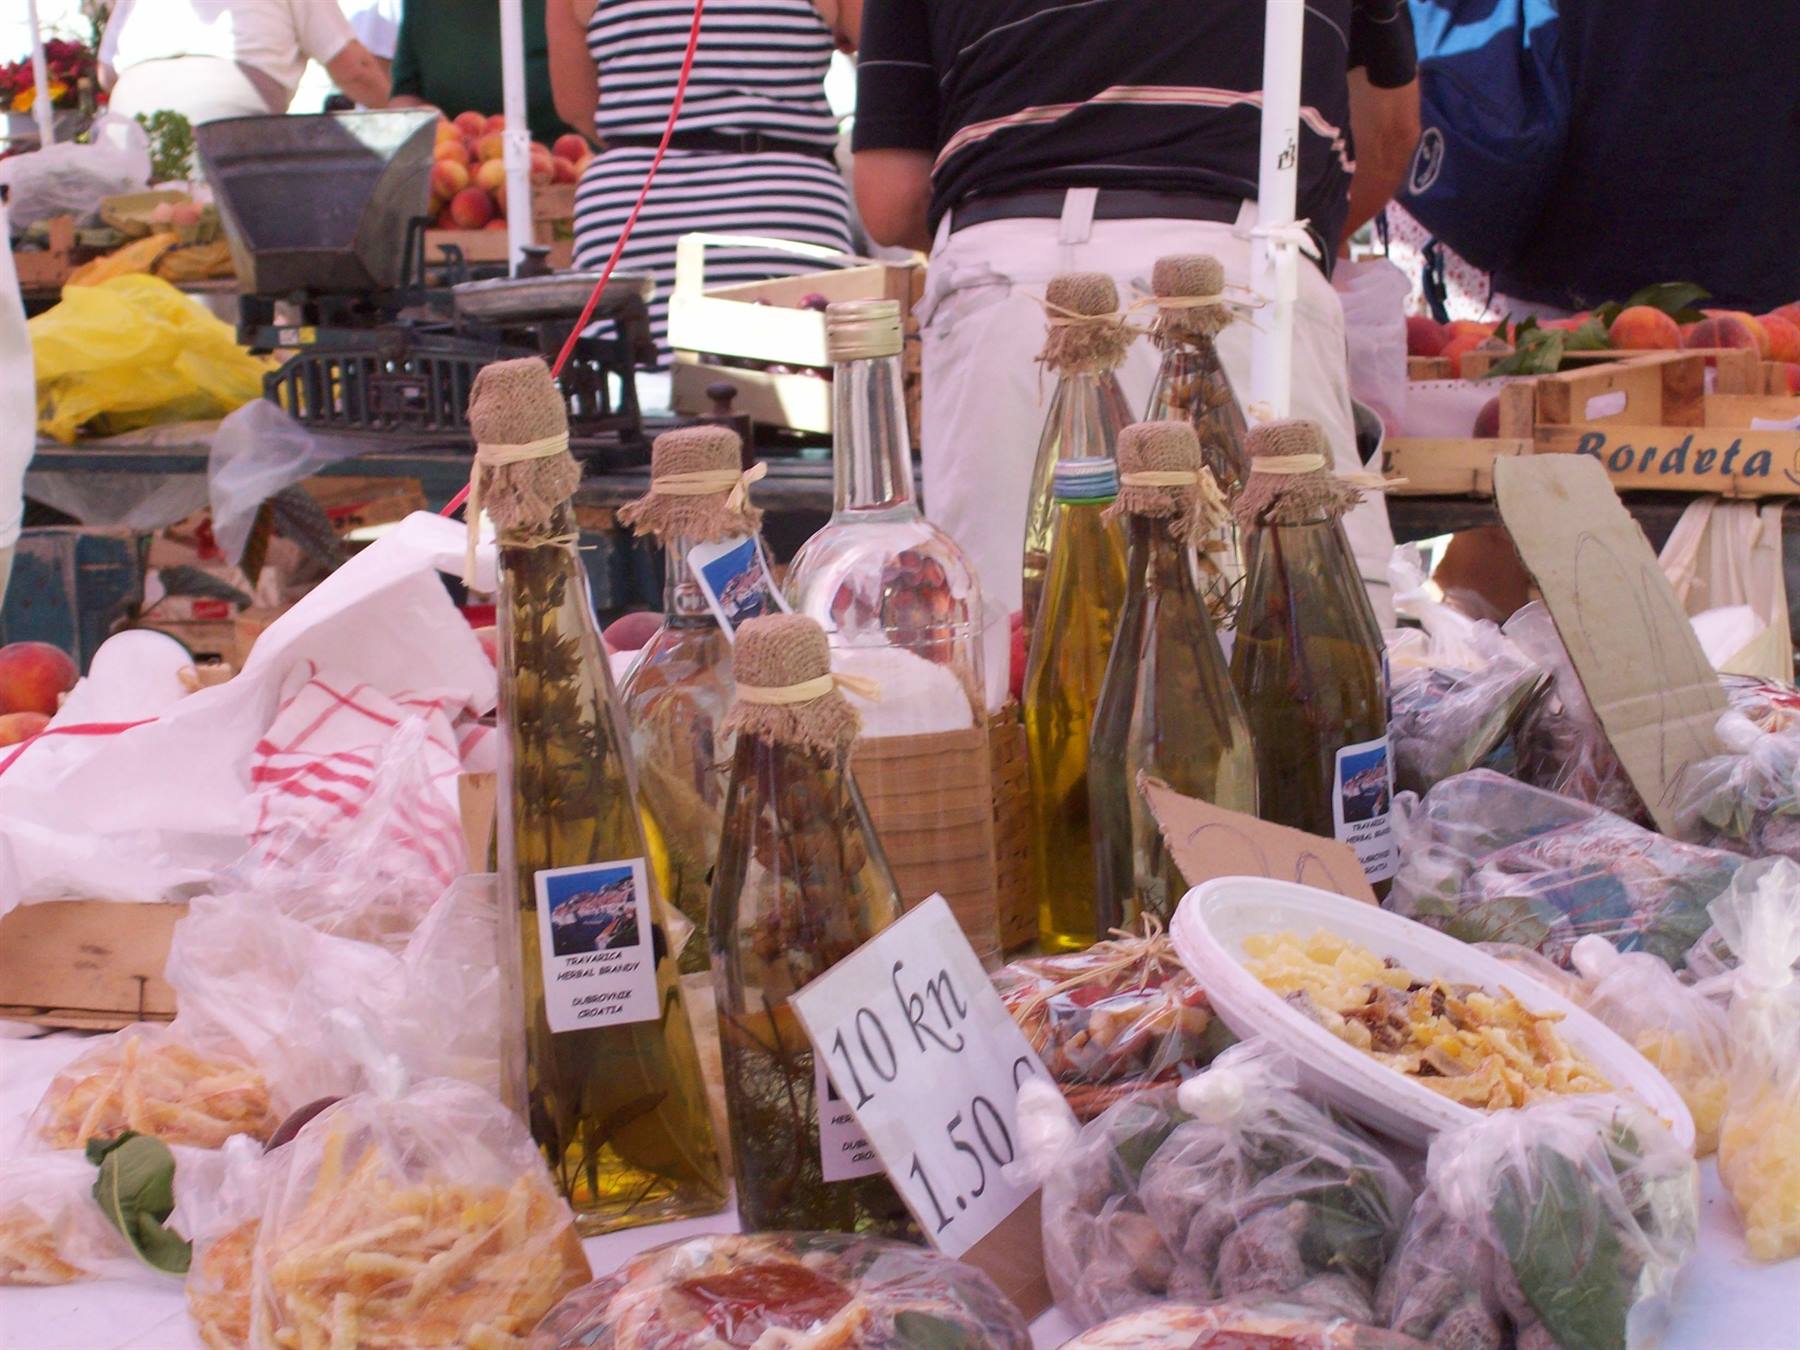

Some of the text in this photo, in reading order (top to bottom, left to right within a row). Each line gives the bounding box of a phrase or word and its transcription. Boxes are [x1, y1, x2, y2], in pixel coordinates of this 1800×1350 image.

[1577, 431, 1773, 477] Bordeta
[566, 951, 622, 966] TRAVARICA
[557, 961, 641, 981] HERBAL BRANDY
[572, 989, 633, 1006] DUBROVNIK
[577, 1005, 624, 1019] CROATIA
[831, 960, 967, 1110] 10 kn
[830, 1112, 855, 1126] HER
[909, 1095, 1015, 1234] 1.50
